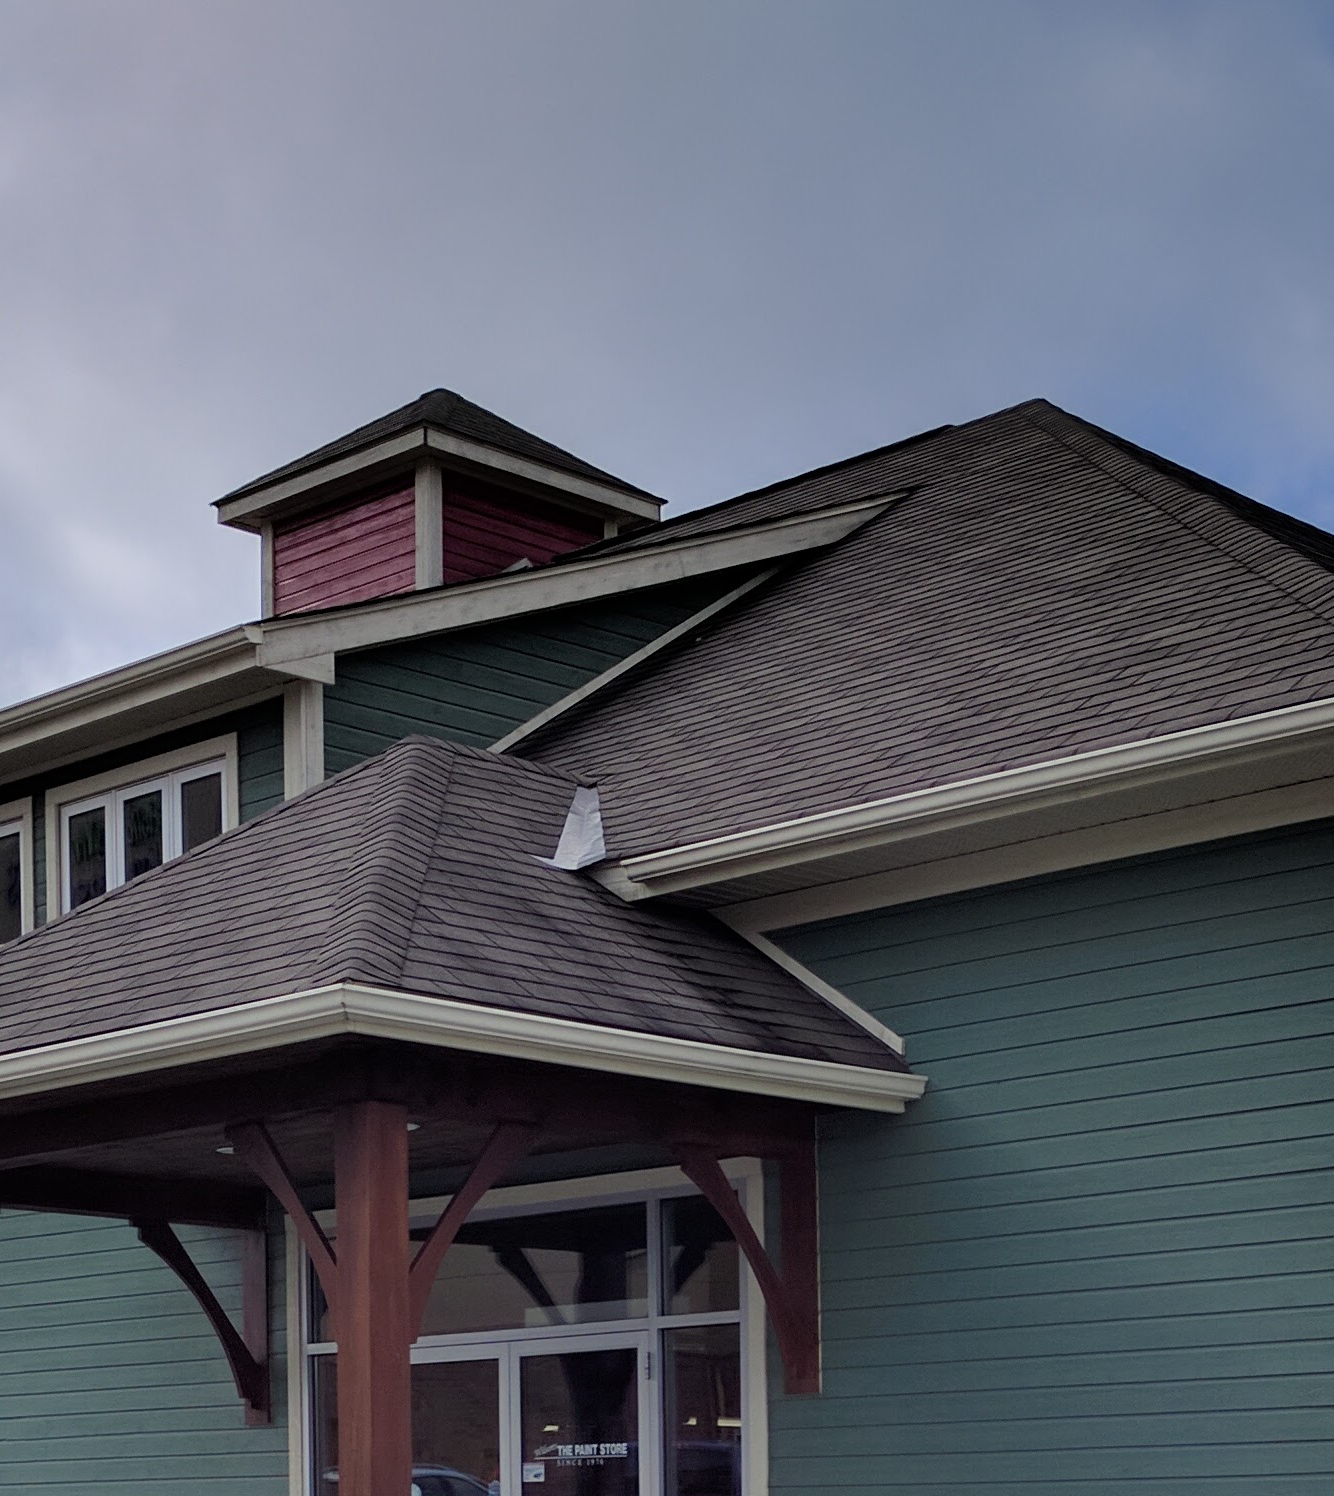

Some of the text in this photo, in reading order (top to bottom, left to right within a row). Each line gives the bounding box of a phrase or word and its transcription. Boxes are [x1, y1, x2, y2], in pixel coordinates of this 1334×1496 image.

[558, 1445, 573, 1456] THE
[574, 1444, 598, 1456] PAINT
[600, 1443, 628, 1455] STORE
